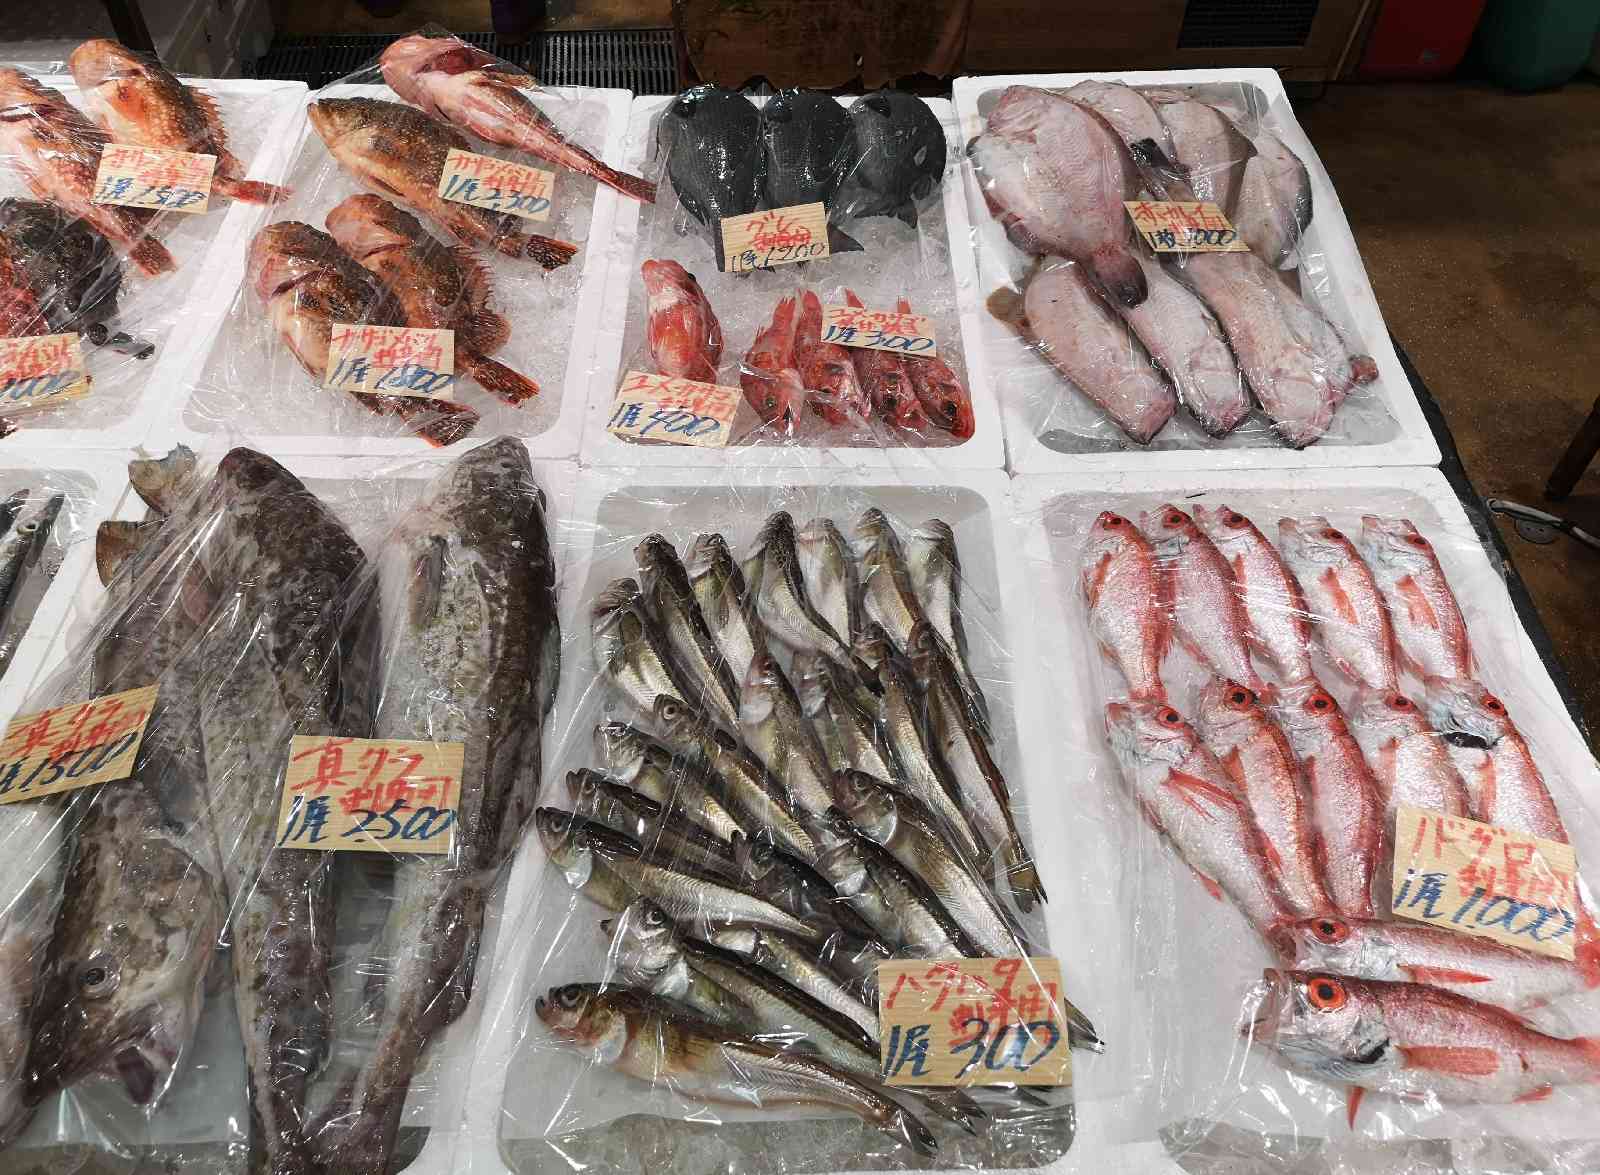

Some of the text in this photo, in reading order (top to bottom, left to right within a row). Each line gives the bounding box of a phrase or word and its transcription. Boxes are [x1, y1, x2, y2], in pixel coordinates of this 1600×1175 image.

[290, 736, 425, 794] 真タラ
[277, 794, 332, 848] 1尾
[1392, 867, 1449, 919] 1尾
[884, 1023, 933, 1079] 1尾
